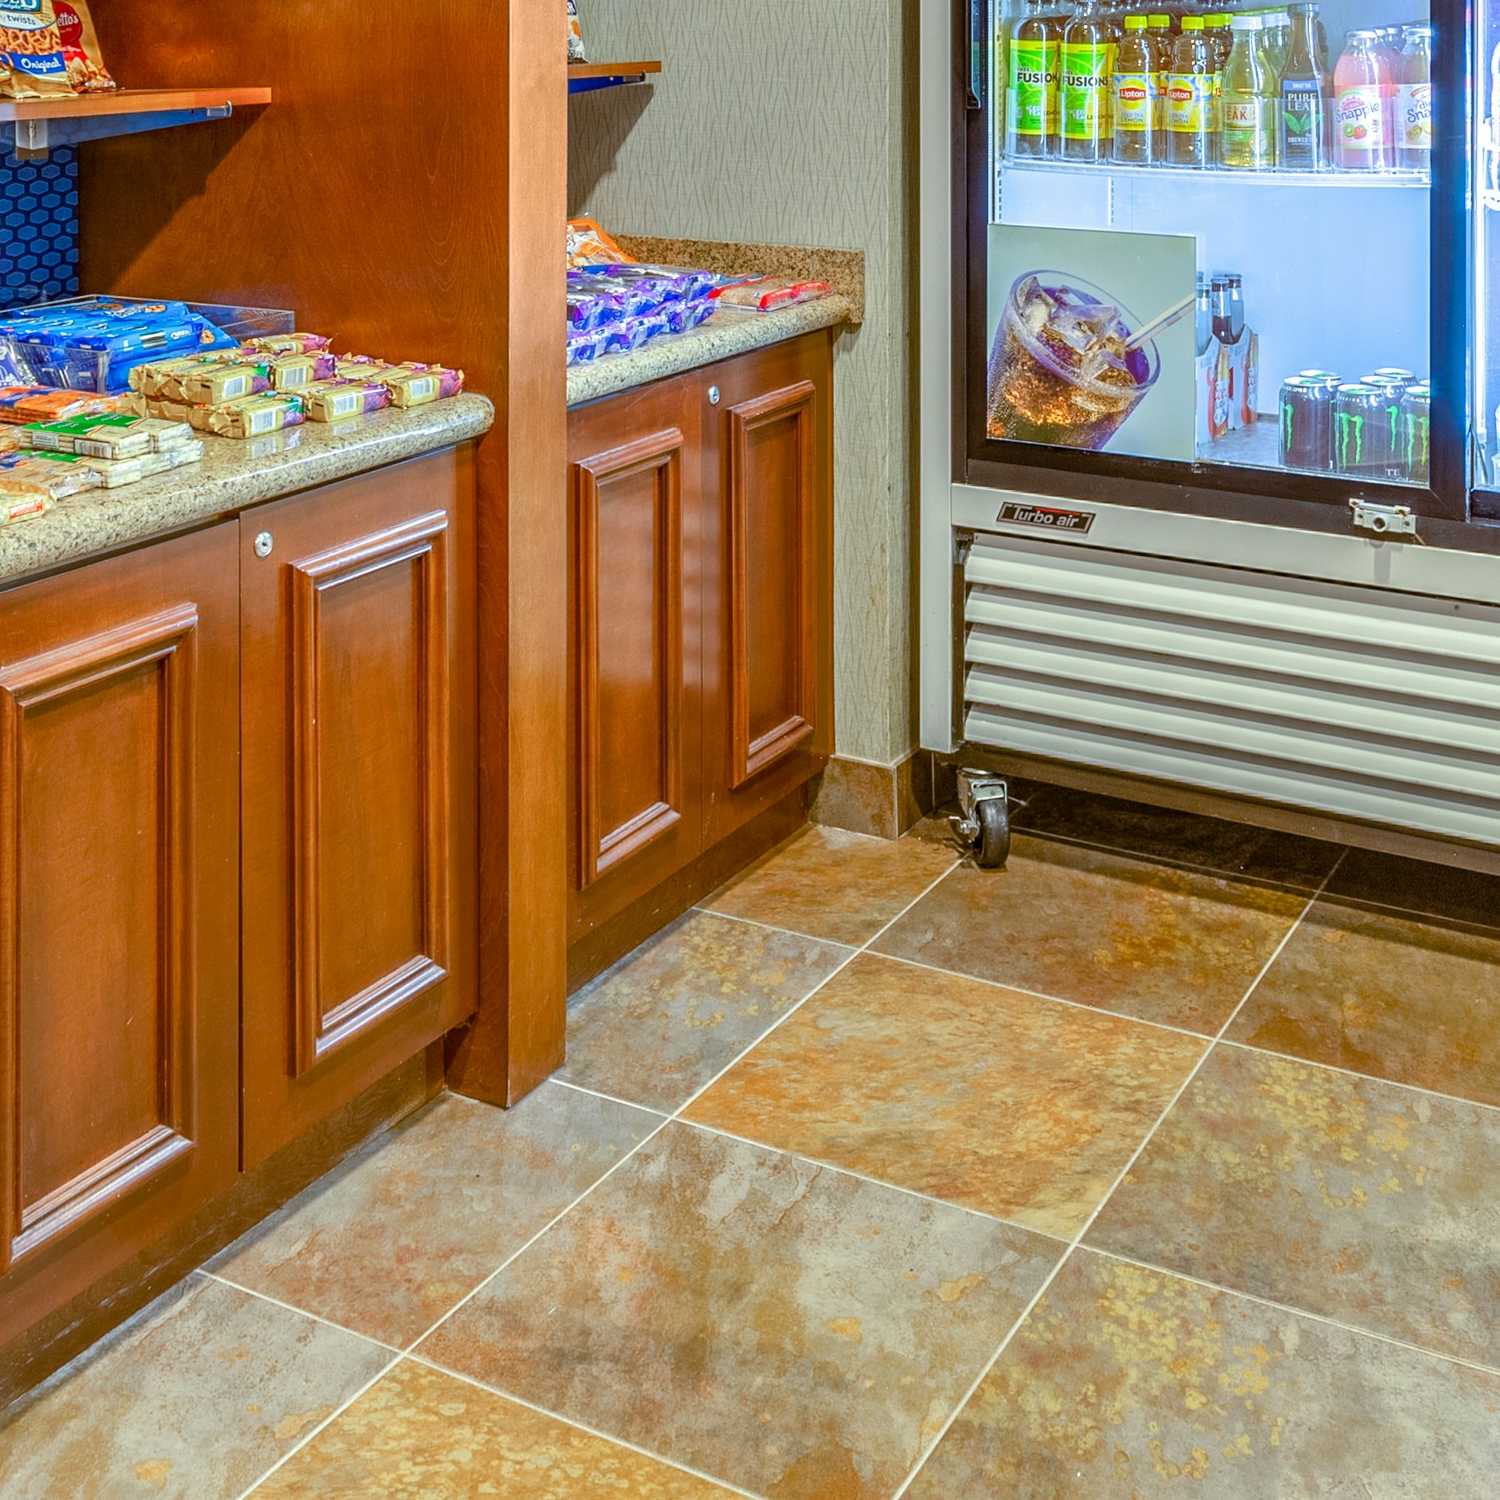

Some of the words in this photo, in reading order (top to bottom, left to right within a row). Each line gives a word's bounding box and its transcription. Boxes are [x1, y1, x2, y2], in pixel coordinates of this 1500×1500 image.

[6, 13, 37, 26] twists
[20, 56, 62, 71] Original
[1016, 72, 1058, 84] FUSION
[1119, 89, 1147, 99] Lipton
[1287, 93, 1317, 103] PURE
[1335, 101, 1380, 123] Snapple
[1012, 504, 1053, 524] Turbo
[1056, 511, 1079, 527] air
